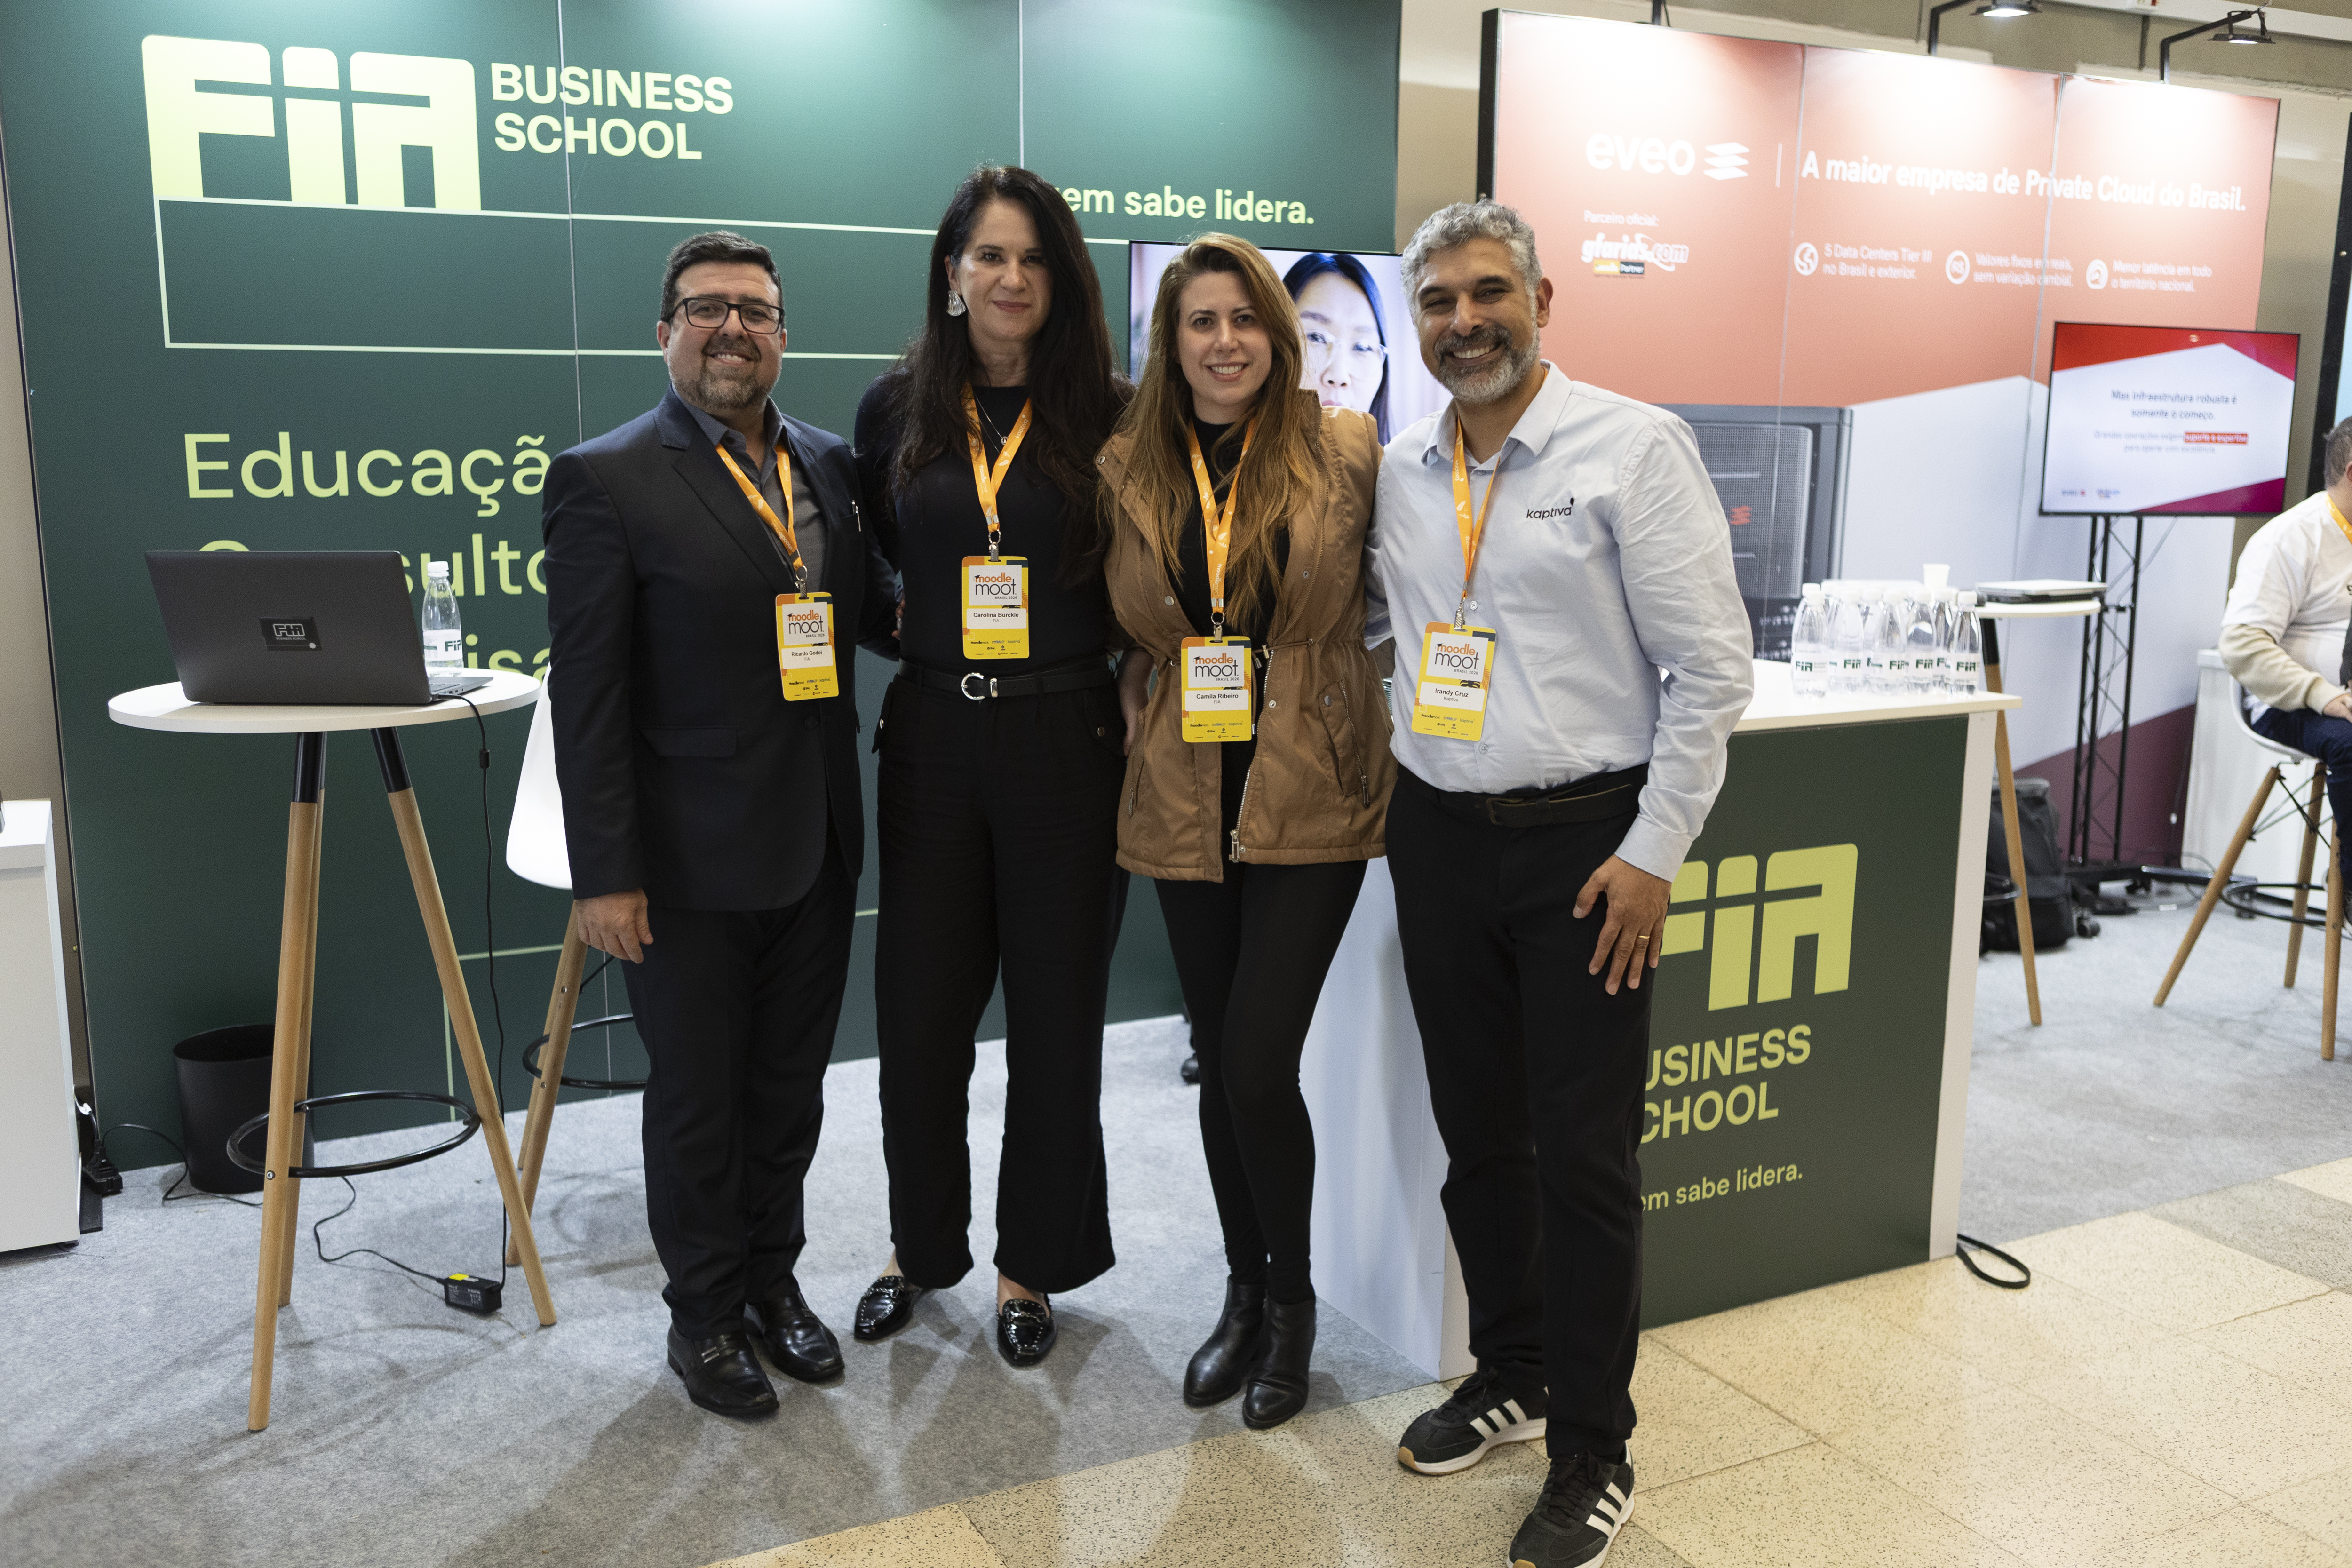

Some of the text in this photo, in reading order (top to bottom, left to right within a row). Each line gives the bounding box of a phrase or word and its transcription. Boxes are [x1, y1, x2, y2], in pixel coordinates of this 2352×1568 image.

[491, 62, 733, 114] BUSINESS
[494, 112, 702, 160] SCHOOL
[1586, 132, 1696, 175] eveo
[1801, 151, 2246, 211] A maior empresa de Private Cloud do Brasil.
[1057, 185, 1314, 224] em sabe lidera.
[1583, 209, 1659, 226] Parceiro oficial:
[1824, 243, 1832, 257] 5
[1833, 243, 1859, 259] Data
[1859, 245, 1899, 261] Centers
[1900, 247, 1921, 263] Tier
[1975, 252, 2010, 267] Valores
[2010, 254, 2033, 268] fixos
[2034, 258, 2049, 269] em
[1822, 261, 1917, 279] no Brasil e exterior.
[2113, 259, 2141, 273] Menor
[2177, 265, 2191, 276] em
[2192, 264, 2212, 277] todo
[1973, 271, 1994, 283] sem
[1995, 271, 2036, 287] variação
[2111, 278, 2118, 288] o
[2111, 390, 2130, 401] Mas
[2132, 390, 2194, 403] infraestrutura
[2196, 392, 2229, 404] robusta
[2131, 409, 2169, 419] somente
[2171, 411, 2177, 420] o
[1015, 419, 1028, 438] kaptiva
[184, 431, 551, 517] Educaçã
[726, 457, 743, 478] kaptiva
[1526, 505, 1573, 520] kaptiva
[975, 573, 1012, 582] moodle
[976, 579, 1016, 595] moot
[788, 610, 819, 621] moodle
[273, 624, 305, 636] FIA
[789, 616, 823, 634] moot
[1195, 653, 1233, 664] moodle
[1437, 644, 1476, 656] moodle
[1195, 660, 1238, 677] moot
[1435, 652, 1479, 669] moot
[1645, 1024, 1811, 1091] USINESS
[1640, 1081, 1779, 1144] CHOOL
[1676, 1176, 1729, 1205] sabe
[1736, 1163, 1803, 1193] lidera.
